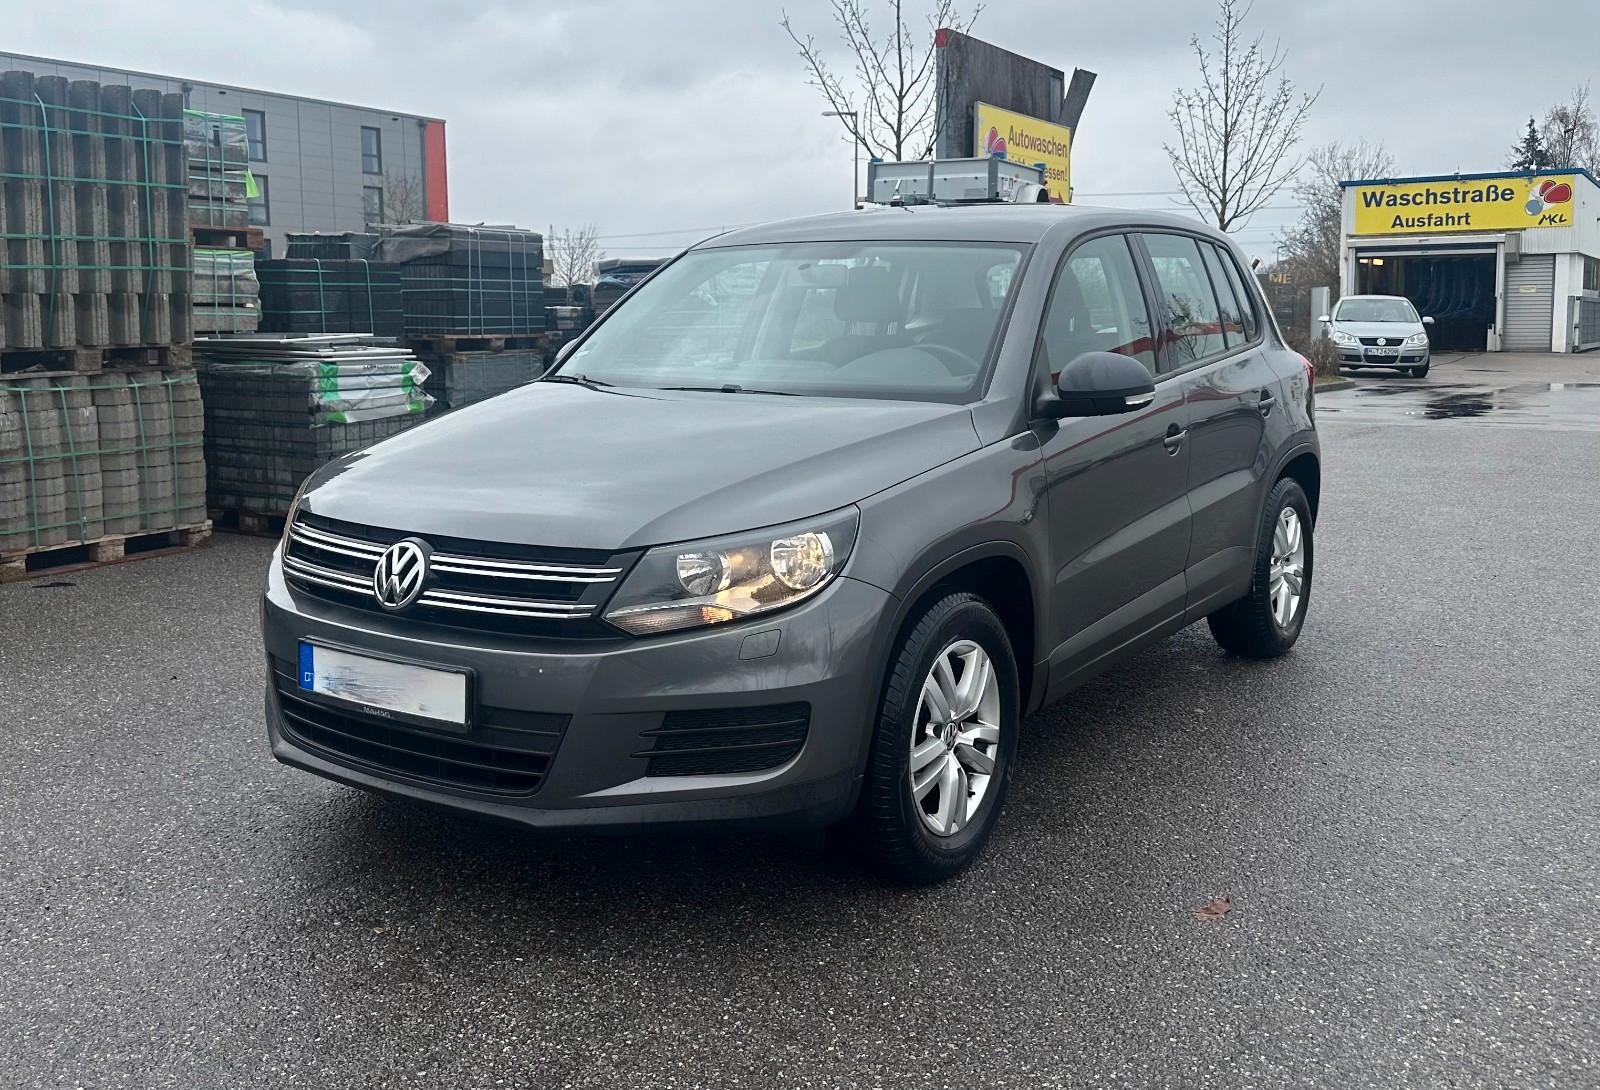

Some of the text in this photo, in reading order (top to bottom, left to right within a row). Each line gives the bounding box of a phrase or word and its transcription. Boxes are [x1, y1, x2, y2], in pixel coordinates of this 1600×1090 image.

[1008, 125, 1067, 158] Autowaschen
[1362, 184, 1515, 208] Waschstraße
[1391, 212, 1471, 228] Ausfahrt
